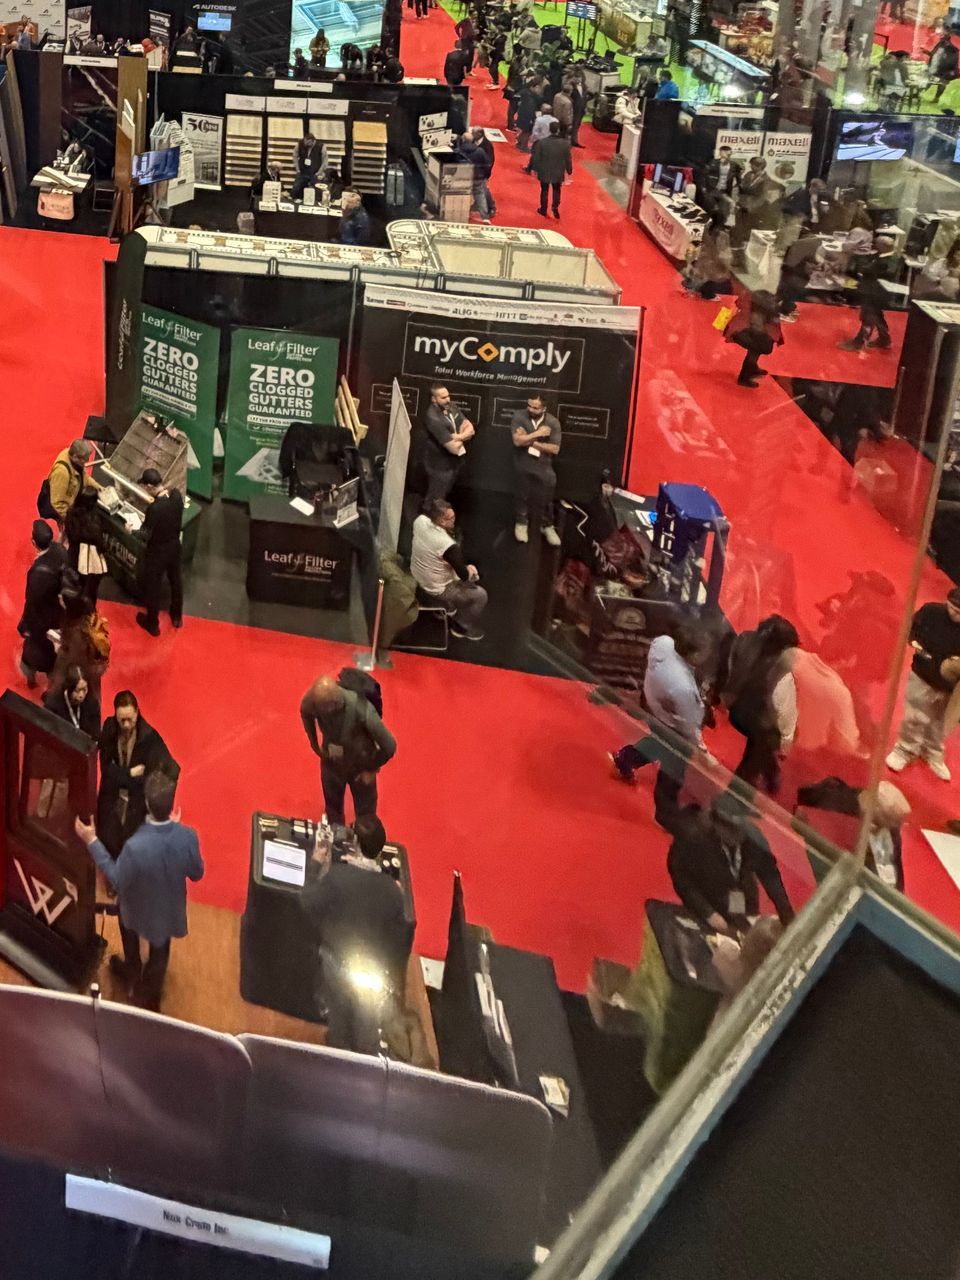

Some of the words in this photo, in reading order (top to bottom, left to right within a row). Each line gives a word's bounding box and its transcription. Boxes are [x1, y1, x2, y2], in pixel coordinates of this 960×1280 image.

[720, 135, 760, 145] maxell
[768, 137, 809, 147] maxell
[143, 337, 199, 371] ZERO
[143, 355, 198, 382] CLOGGED
[250, 364, 315, 387] ZERO
[434, 366, 453, 375] Total
[455, 368, 494, 380] Workforce
[496, 373, 547, 384] Management
[142, 375, 197, 401] GUARANTEED
[143, 365, 197, 393] GUTTERS
[249, 382, 314, 398] CLOGGED
[249, 393, 313, 410] GUTTERS
[248, 404, 313, 418] GUARANTEED
[264, 550, 293, 564] Leaf
[305, 555, 338, 569] Filter
